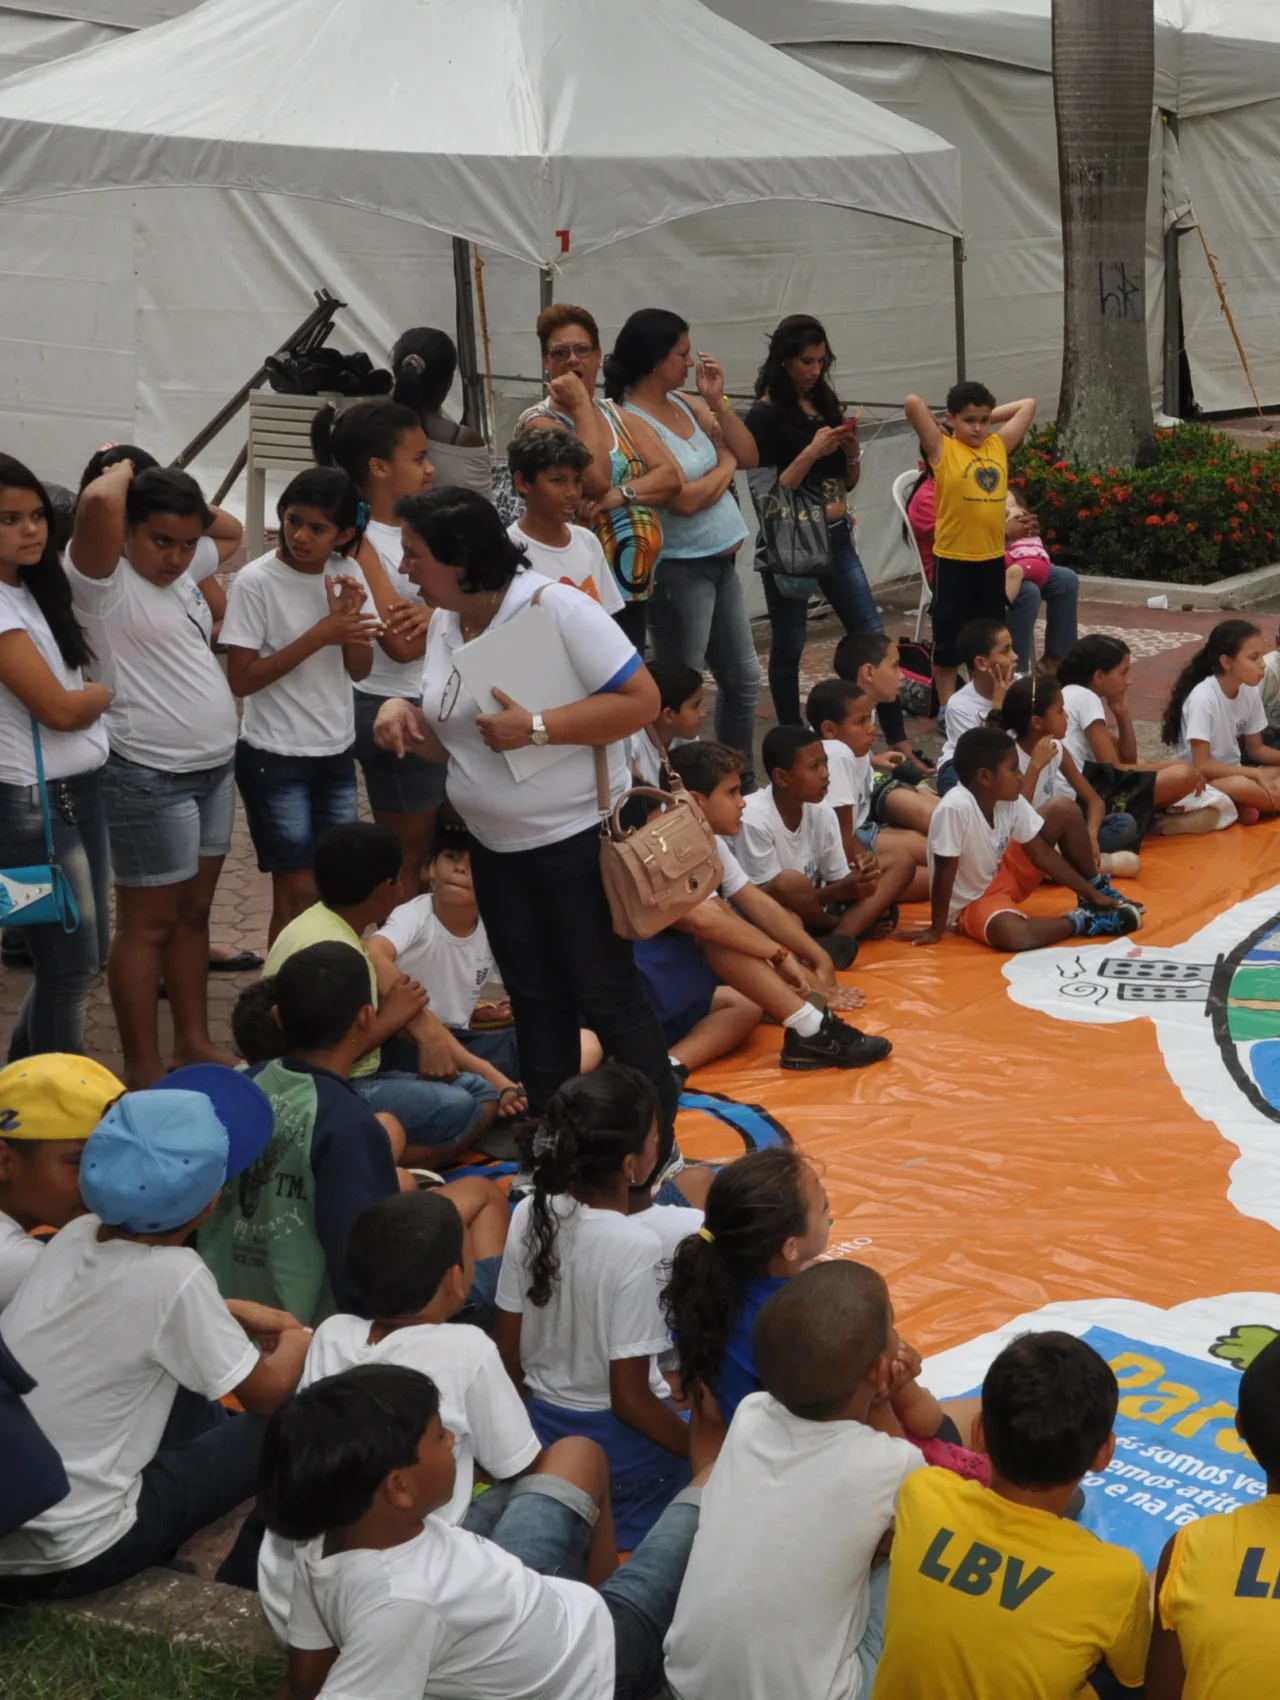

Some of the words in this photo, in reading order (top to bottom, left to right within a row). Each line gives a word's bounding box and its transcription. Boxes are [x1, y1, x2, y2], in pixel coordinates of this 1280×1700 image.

[1107, 1459, 1182, 1490] emos
[1139, 1445, 1234, 1485] somos
[1104, 1483, 1129, 1498] e
[1123, 1491, 1168, 1516] na
[918, 1527, 1056, 1612] LBV
